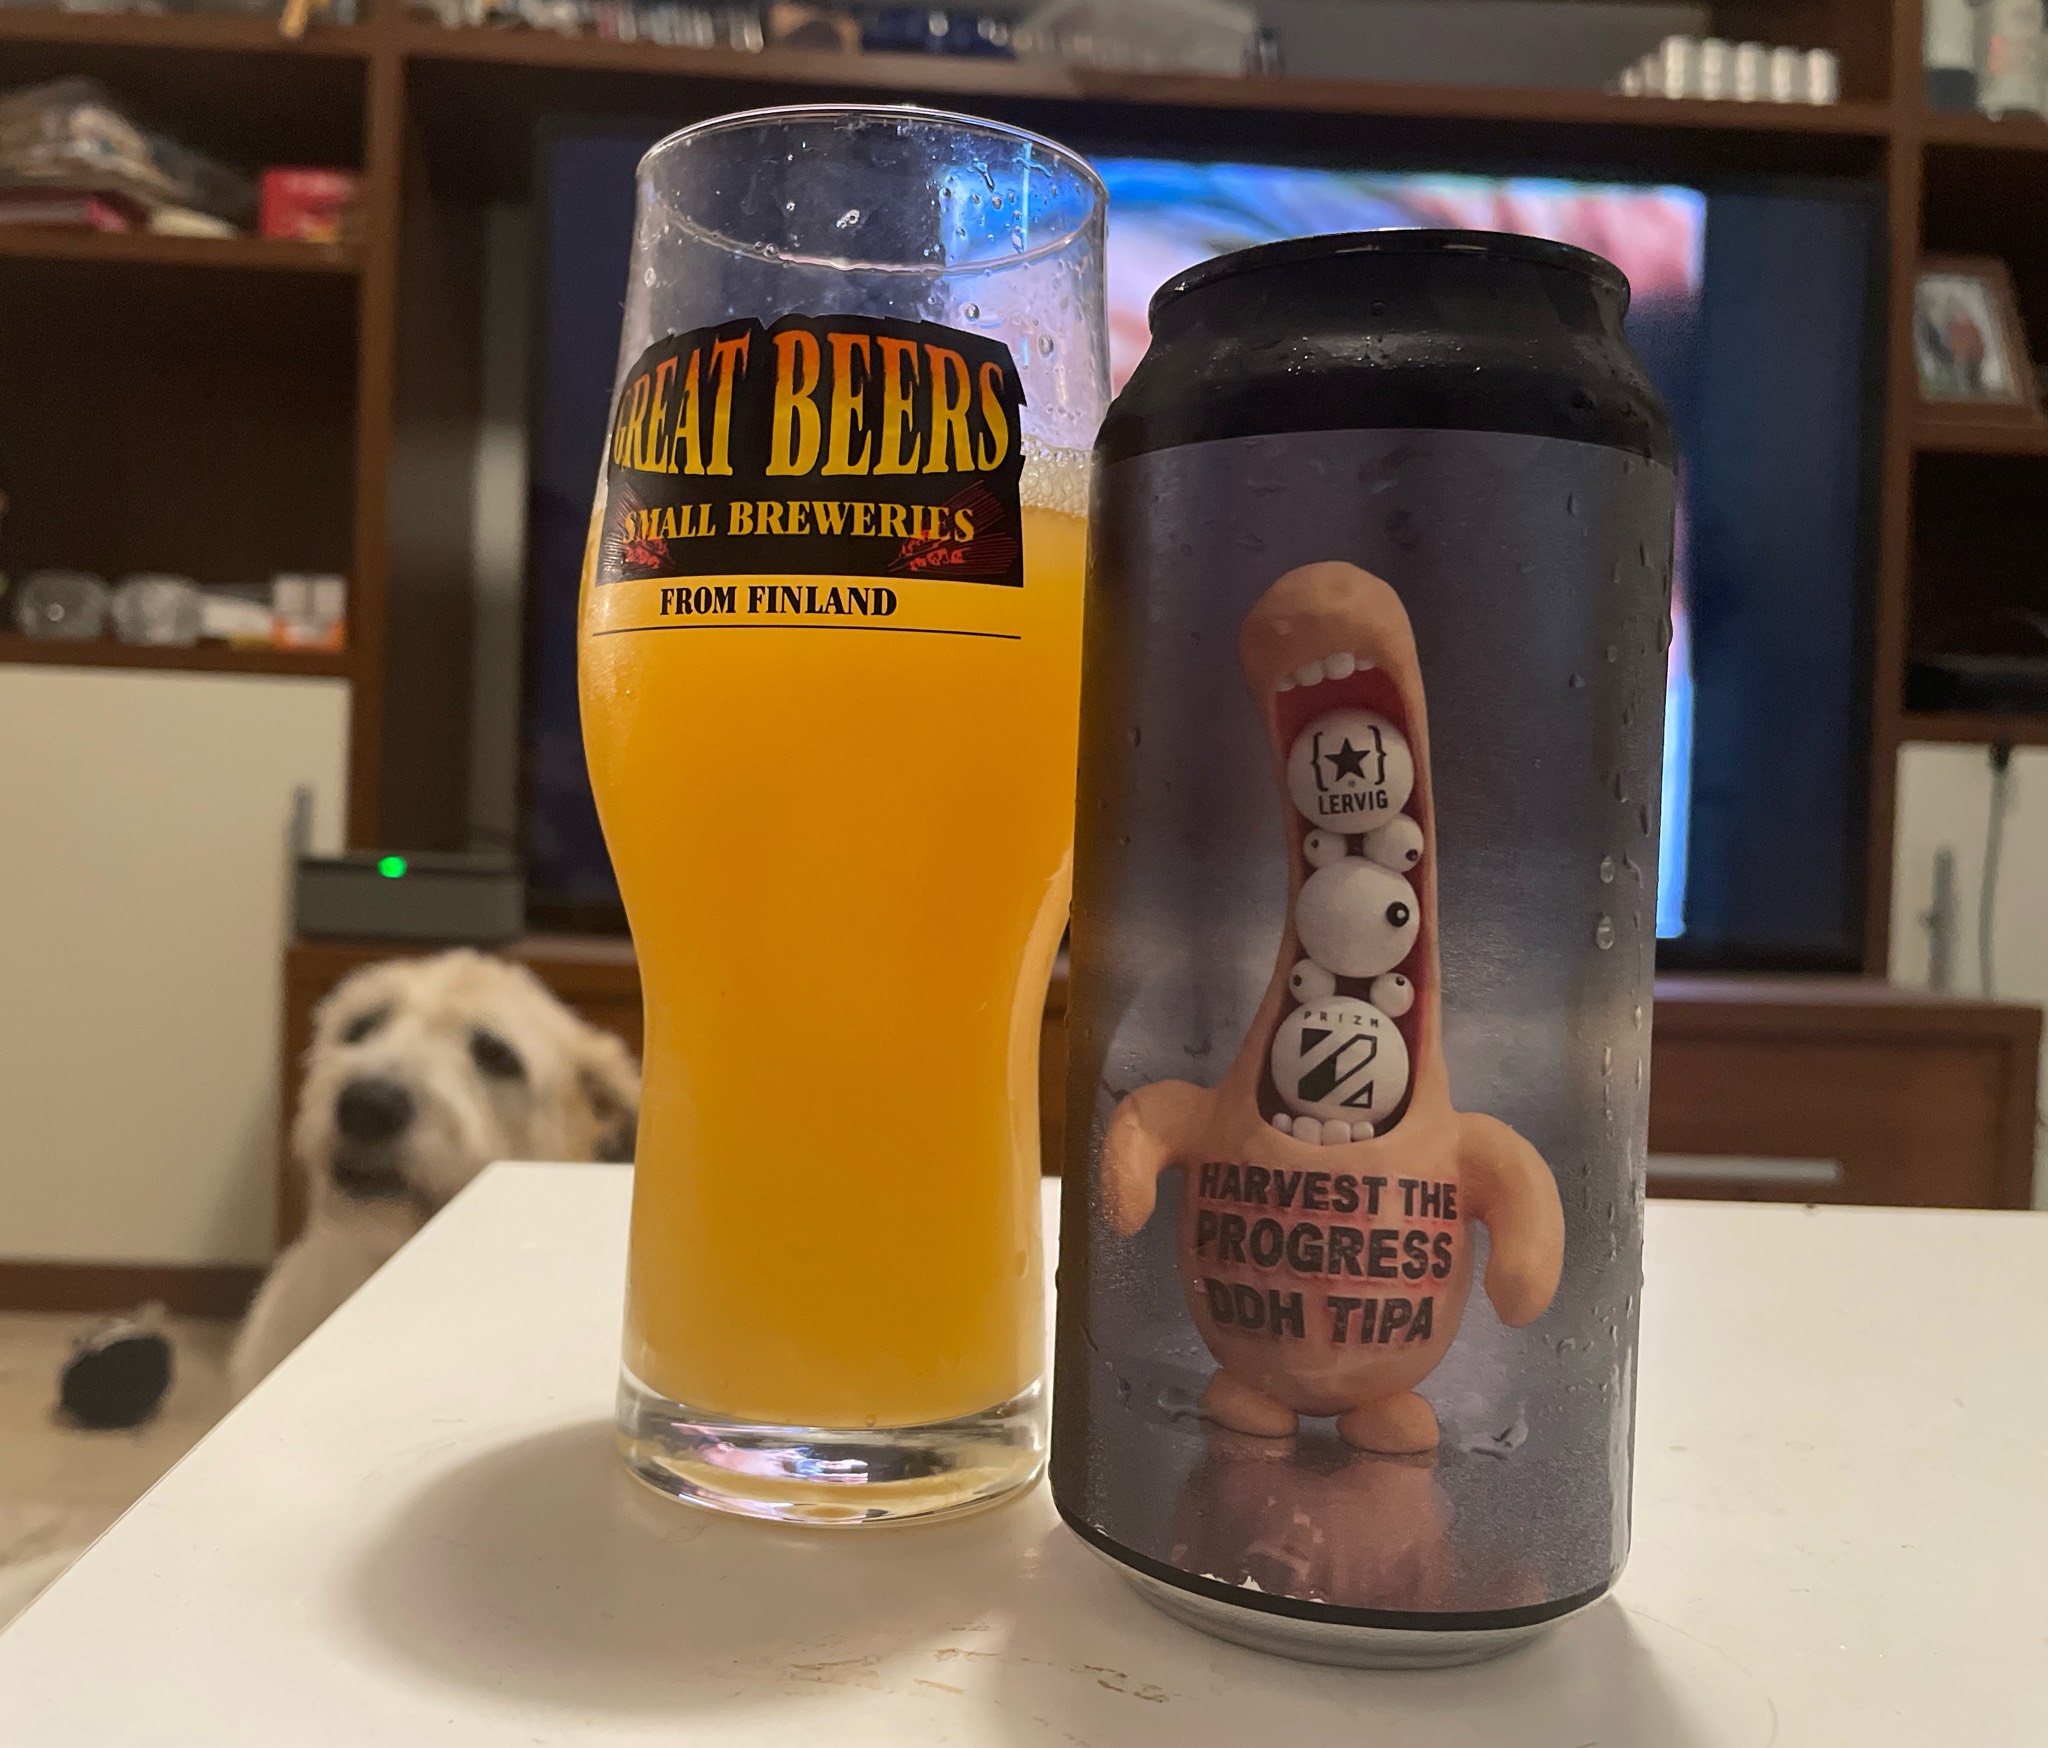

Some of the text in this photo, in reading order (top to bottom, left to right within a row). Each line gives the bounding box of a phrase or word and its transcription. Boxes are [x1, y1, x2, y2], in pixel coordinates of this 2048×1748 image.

[612, 329, 1010, 476] GREAT BEERS
[624, 500, 975, 543] SMALL BREWERIES
[660, 584, 898, 616] FROM FINLAND
[1318, 790, 1389, 815] LERVIG
[1303, 1010, 1381, 1028] PRIZM
[1199, 1163, 1457, 1219] HARVEST THE
[1196, 1210, 1453, 1281] PROGRESS
[1203, 1276, 1435, 1344] DDH TIPA
